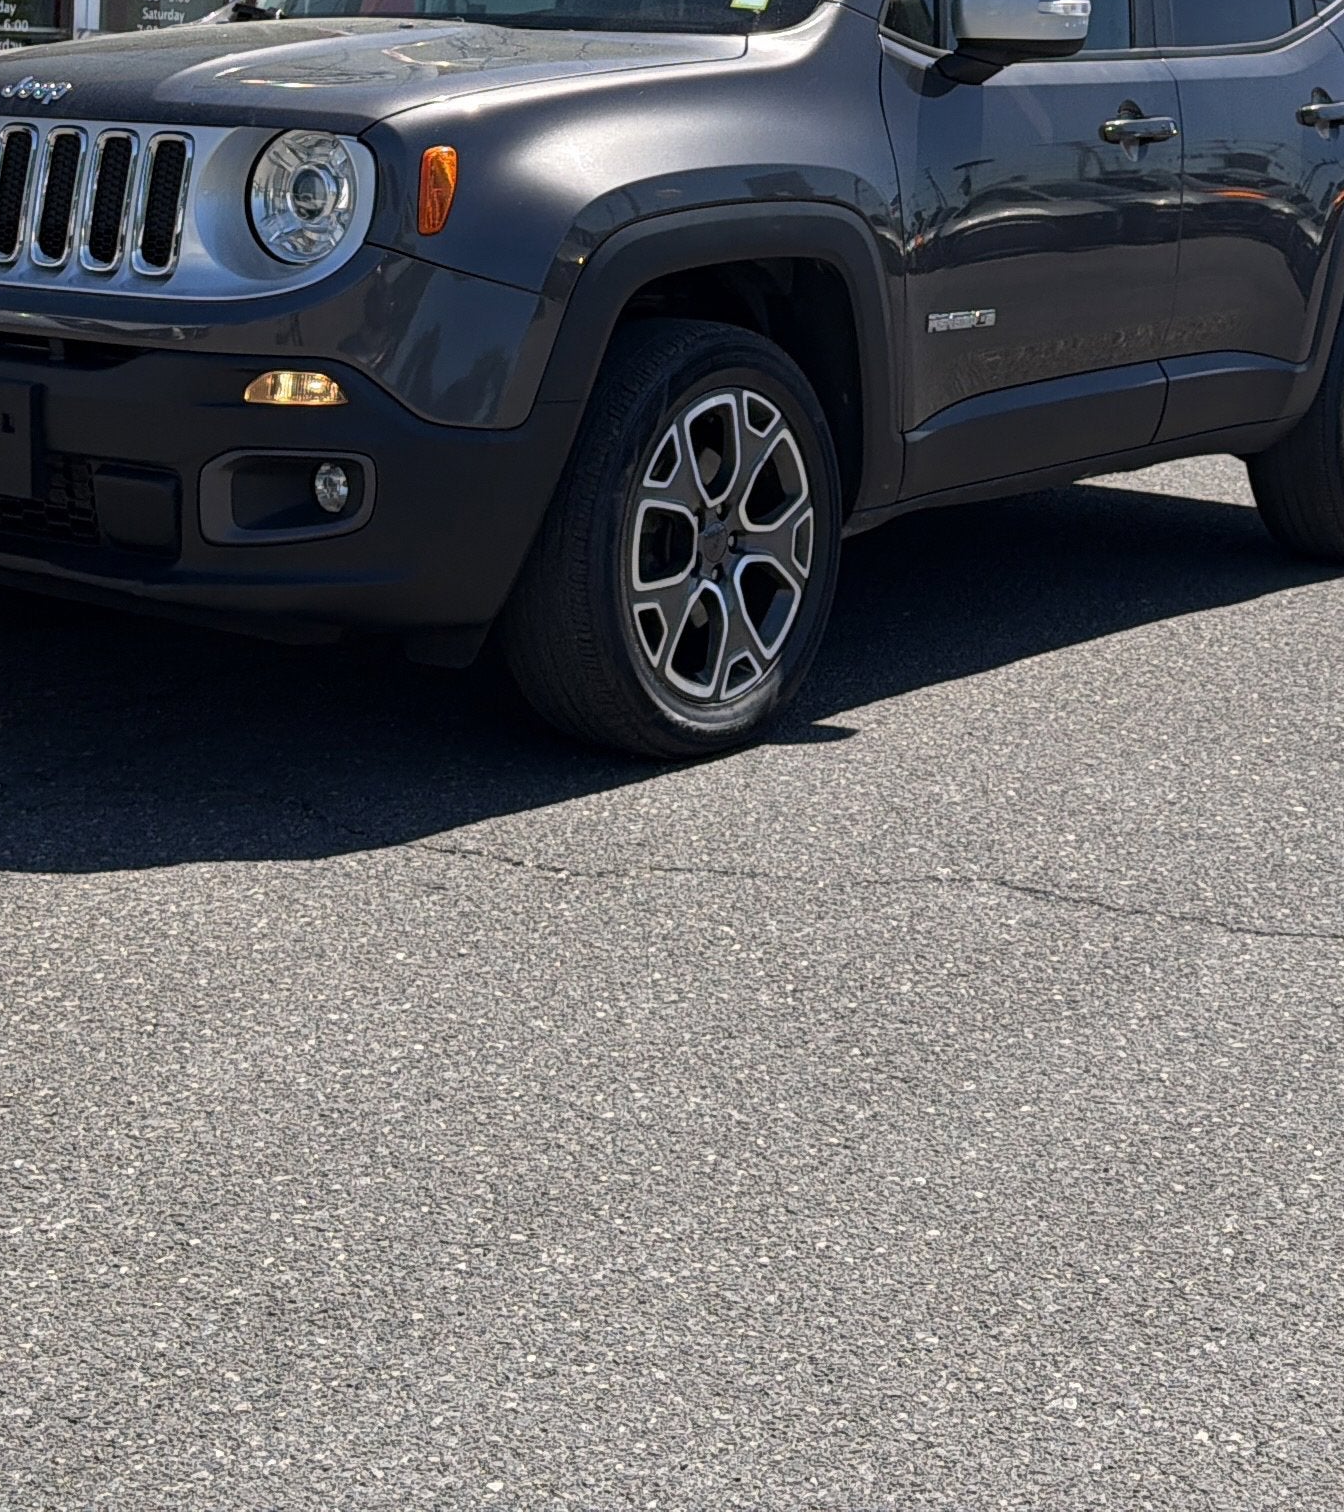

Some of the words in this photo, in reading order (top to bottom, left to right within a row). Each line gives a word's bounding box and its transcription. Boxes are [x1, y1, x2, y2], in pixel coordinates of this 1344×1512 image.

[142, 6, 186, 24] Saturday
[3, 18, 29, 32] 6:00
[0, 75, 73, 105] Jeep
